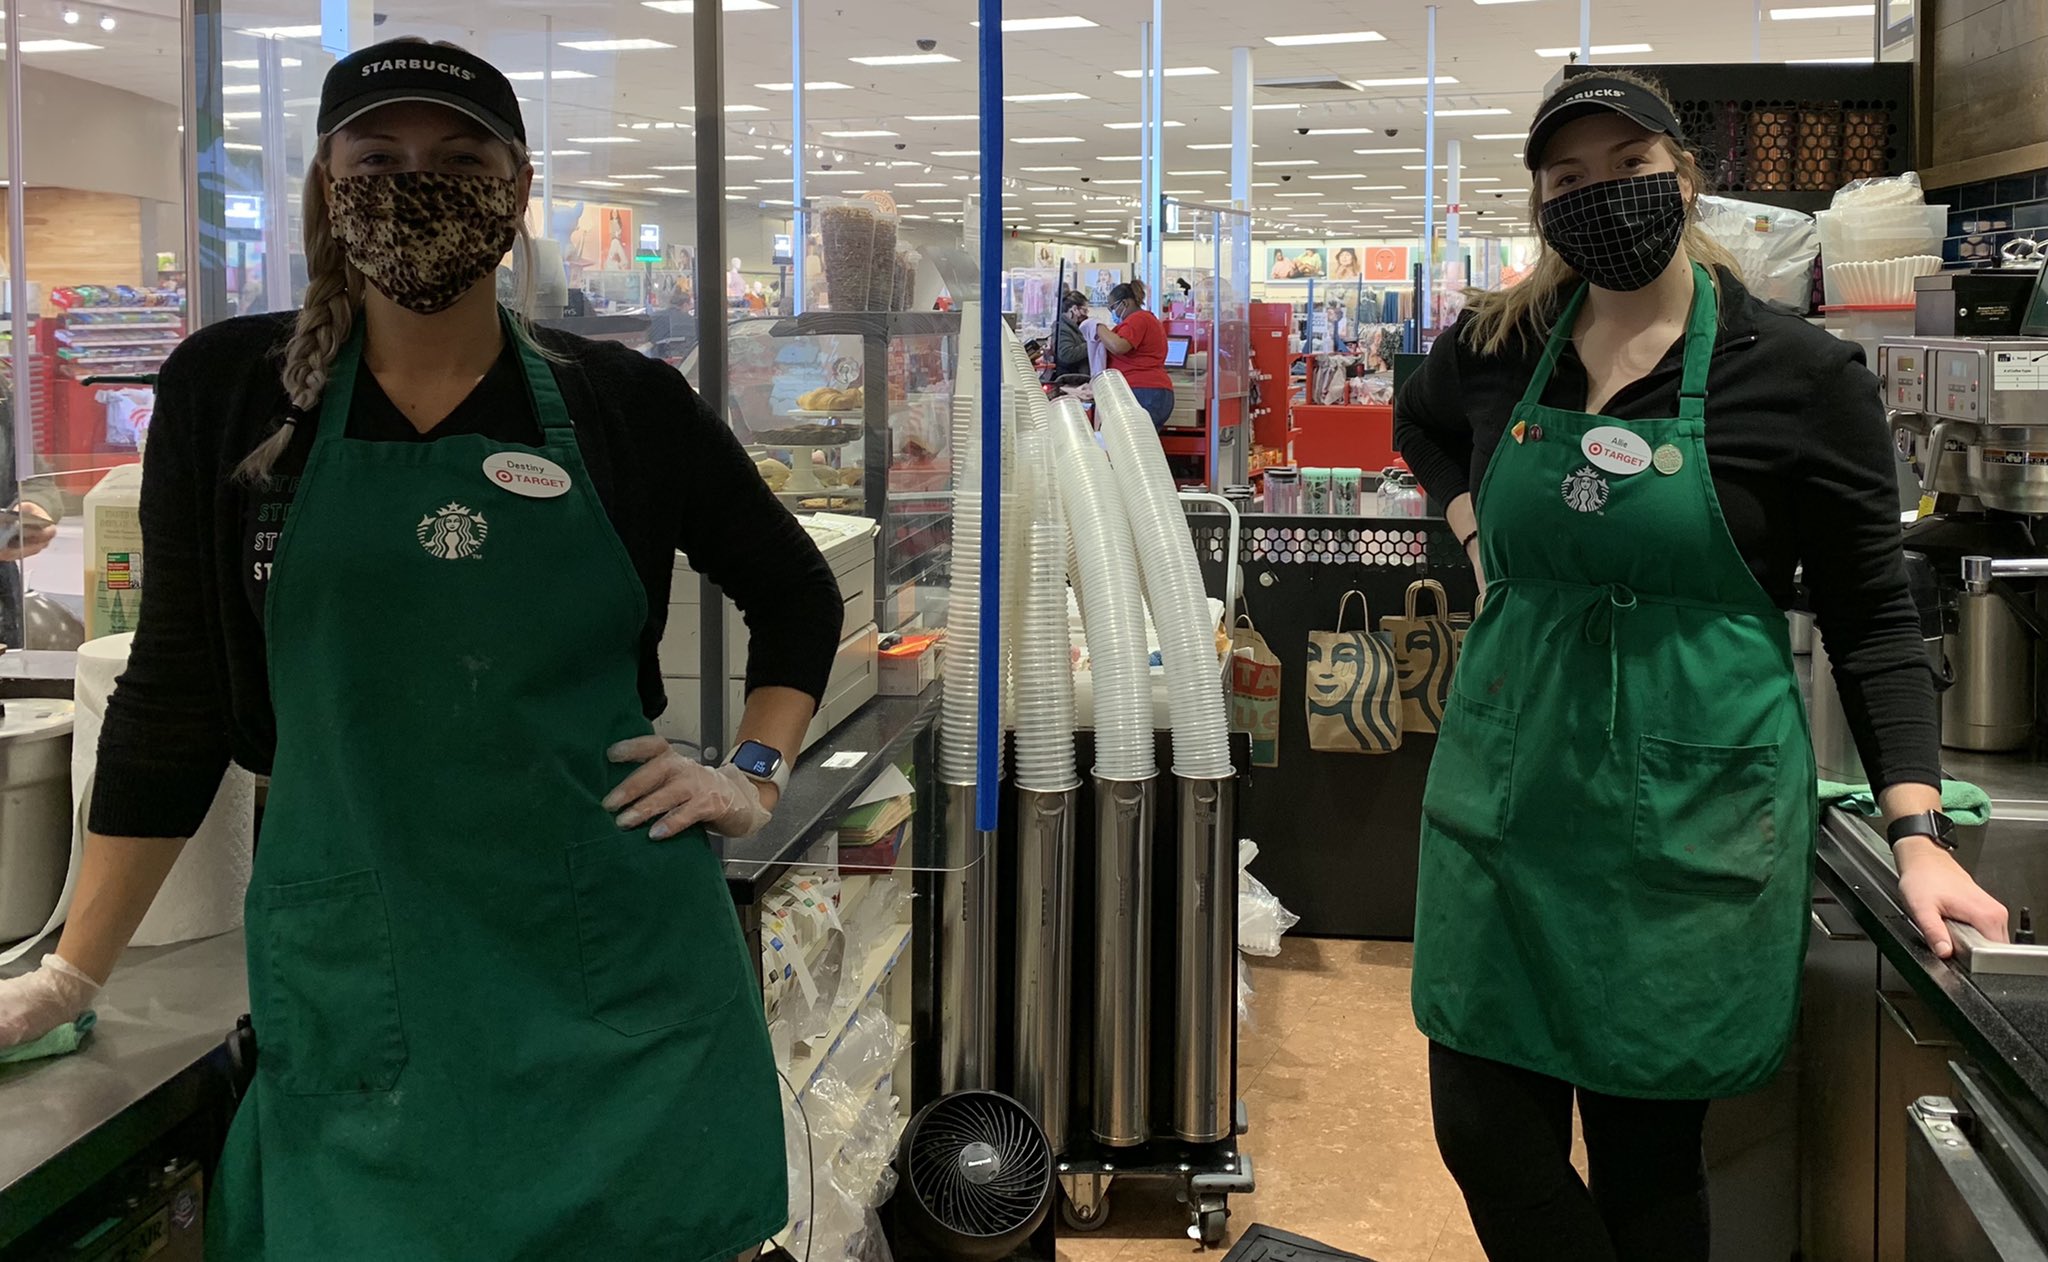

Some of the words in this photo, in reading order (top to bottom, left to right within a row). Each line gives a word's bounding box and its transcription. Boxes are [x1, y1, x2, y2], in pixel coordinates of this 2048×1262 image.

[361, 58, 472, 81] STARBUCKS
[506, 460, 545, 474] Destiny
[1604, 448, 1644, 467] TARGET
[515, 474, 565, 488] TARGET
[254, 532, 283, 551] ST
